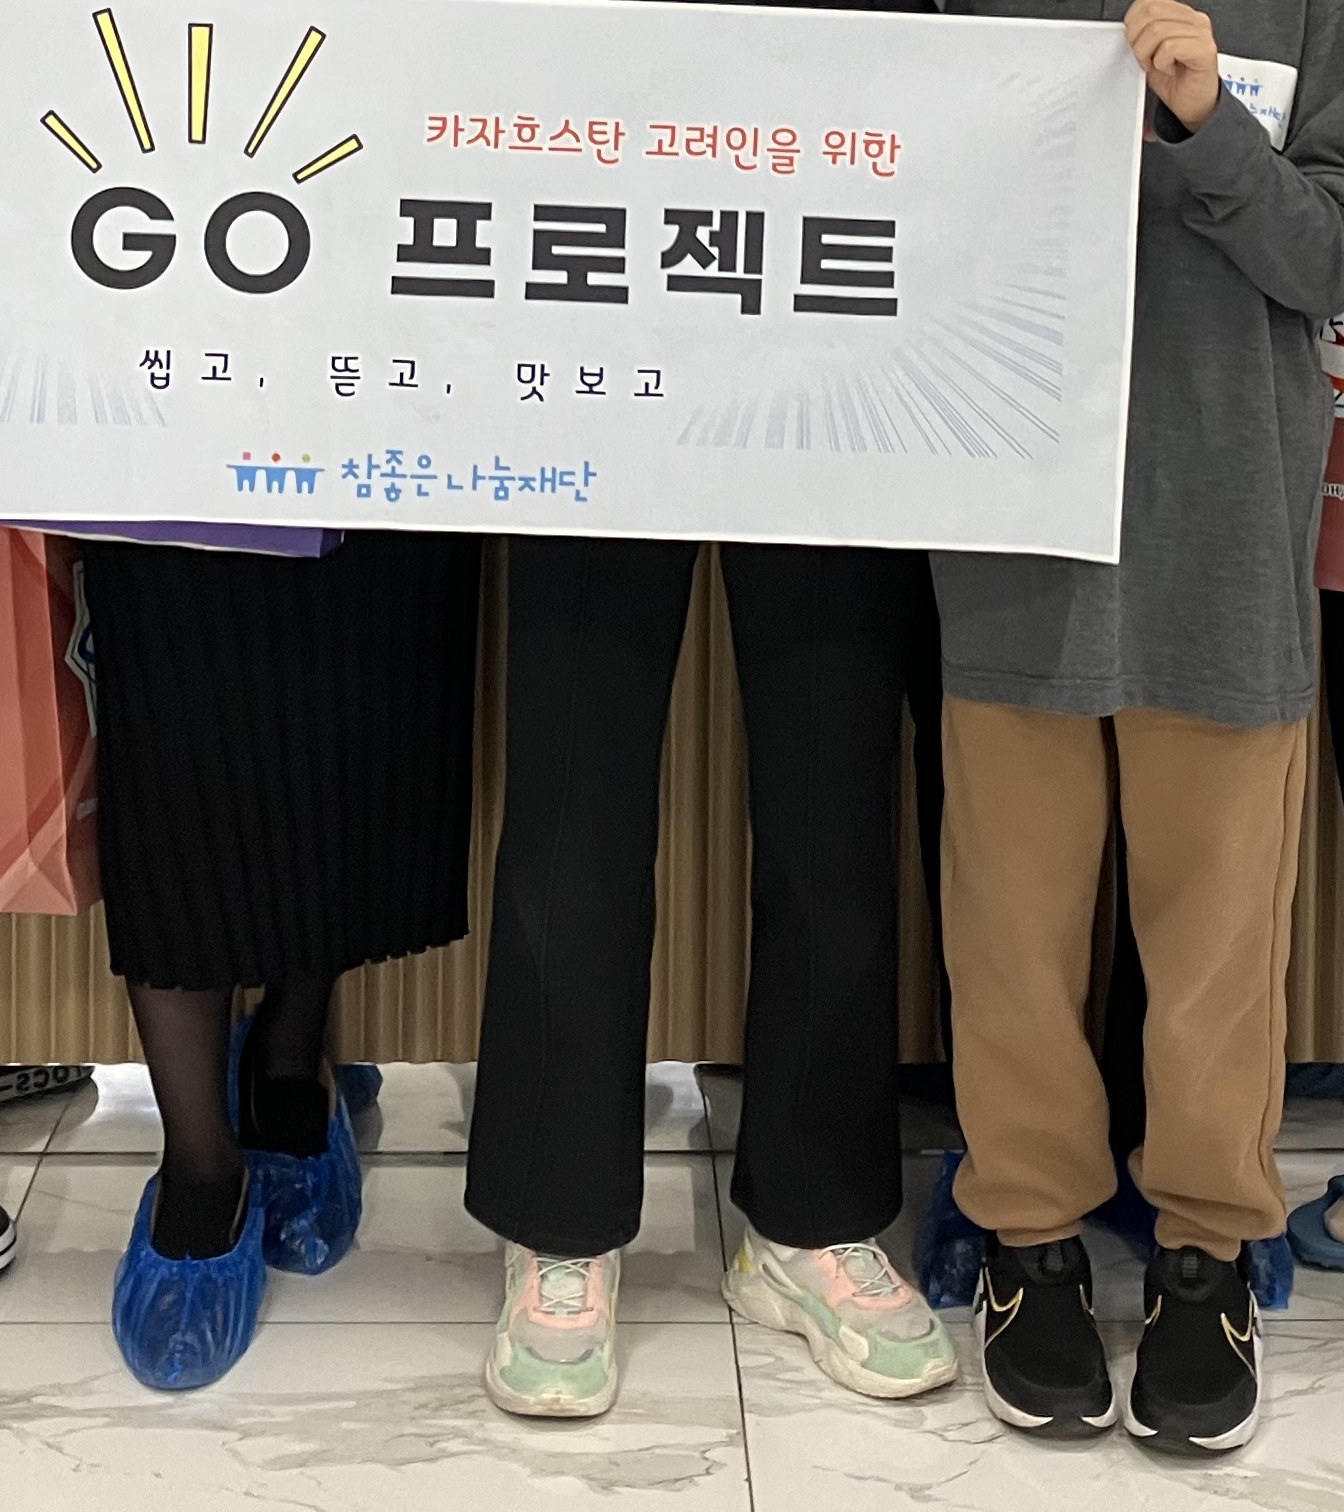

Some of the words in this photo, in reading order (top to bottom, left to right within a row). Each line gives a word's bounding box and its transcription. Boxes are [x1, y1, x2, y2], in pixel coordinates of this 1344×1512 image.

[645, 124, 801, 175] 고려인을
[822, 131, 901, 177] 위한
[70, 186, 312, 294] GO
[390, 197, 898, 317] 프로젝트
[341, 448, 598, 503] 참좋은나눔재단
